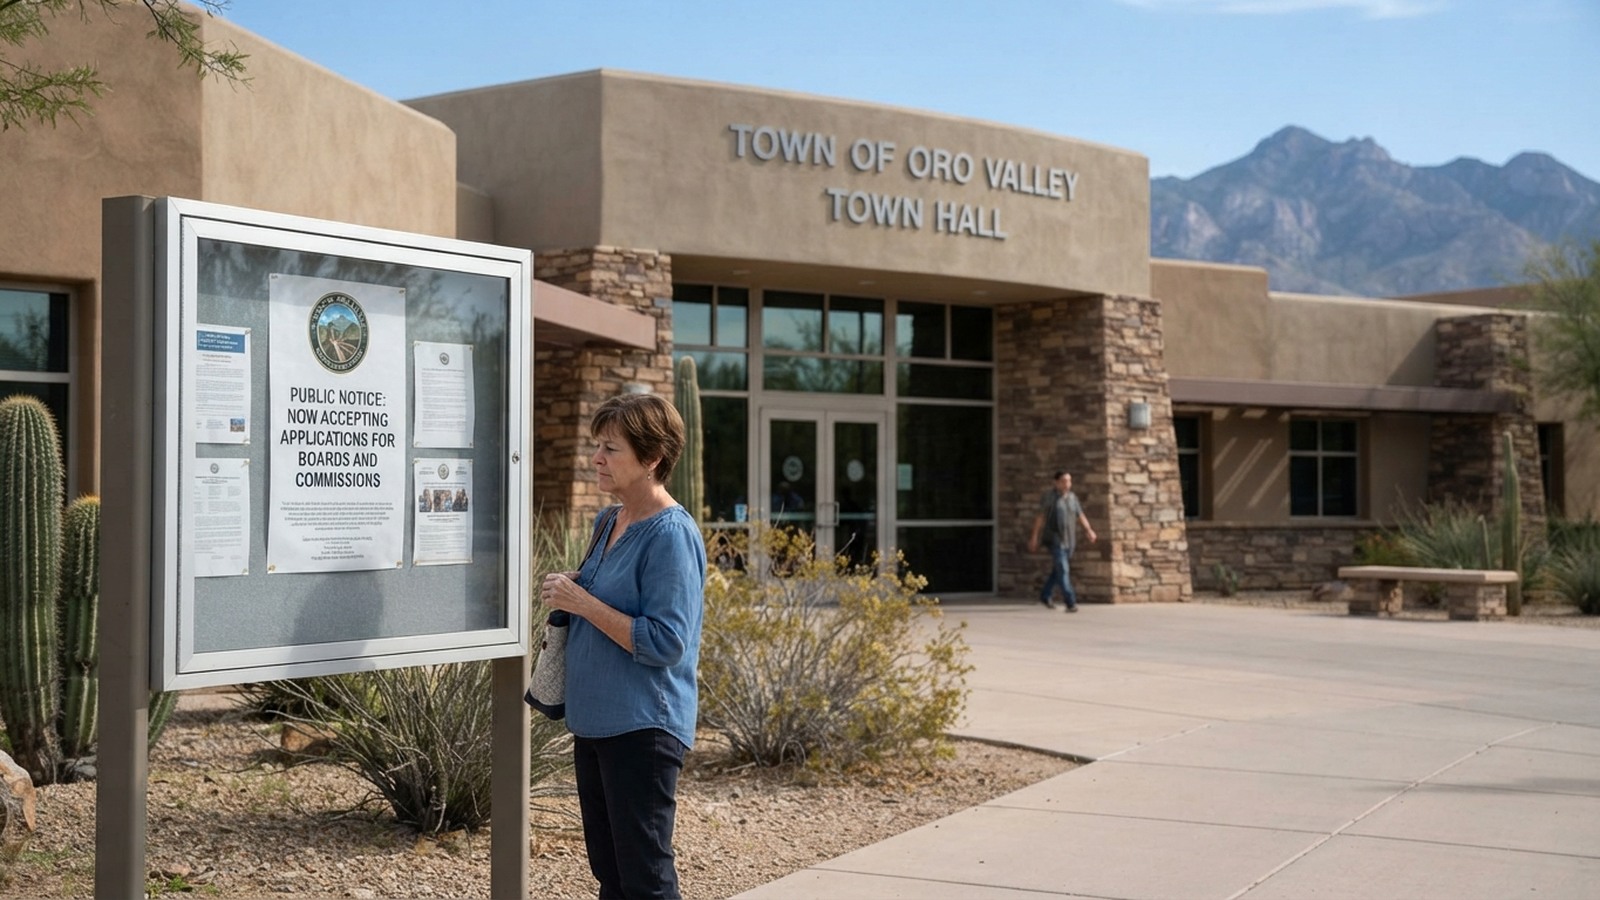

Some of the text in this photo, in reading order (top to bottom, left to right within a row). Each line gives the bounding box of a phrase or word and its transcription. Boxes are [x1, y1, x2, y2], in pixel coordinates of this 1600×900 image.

[728, 122, 1079, 201] TOWN OF ORO VALLEY
[825, 187, 1008, 240] TOWN HALL
[290, 387, 386, 406] PUBLIC NOTICE:
[287, 408, 388, 427] NOW ACCEPTING
[371, 432, 395, 447] FOR
[298, 451, 377, 467] BOARDS AND
[295, 472, 381, 487] COMMISSIONS
